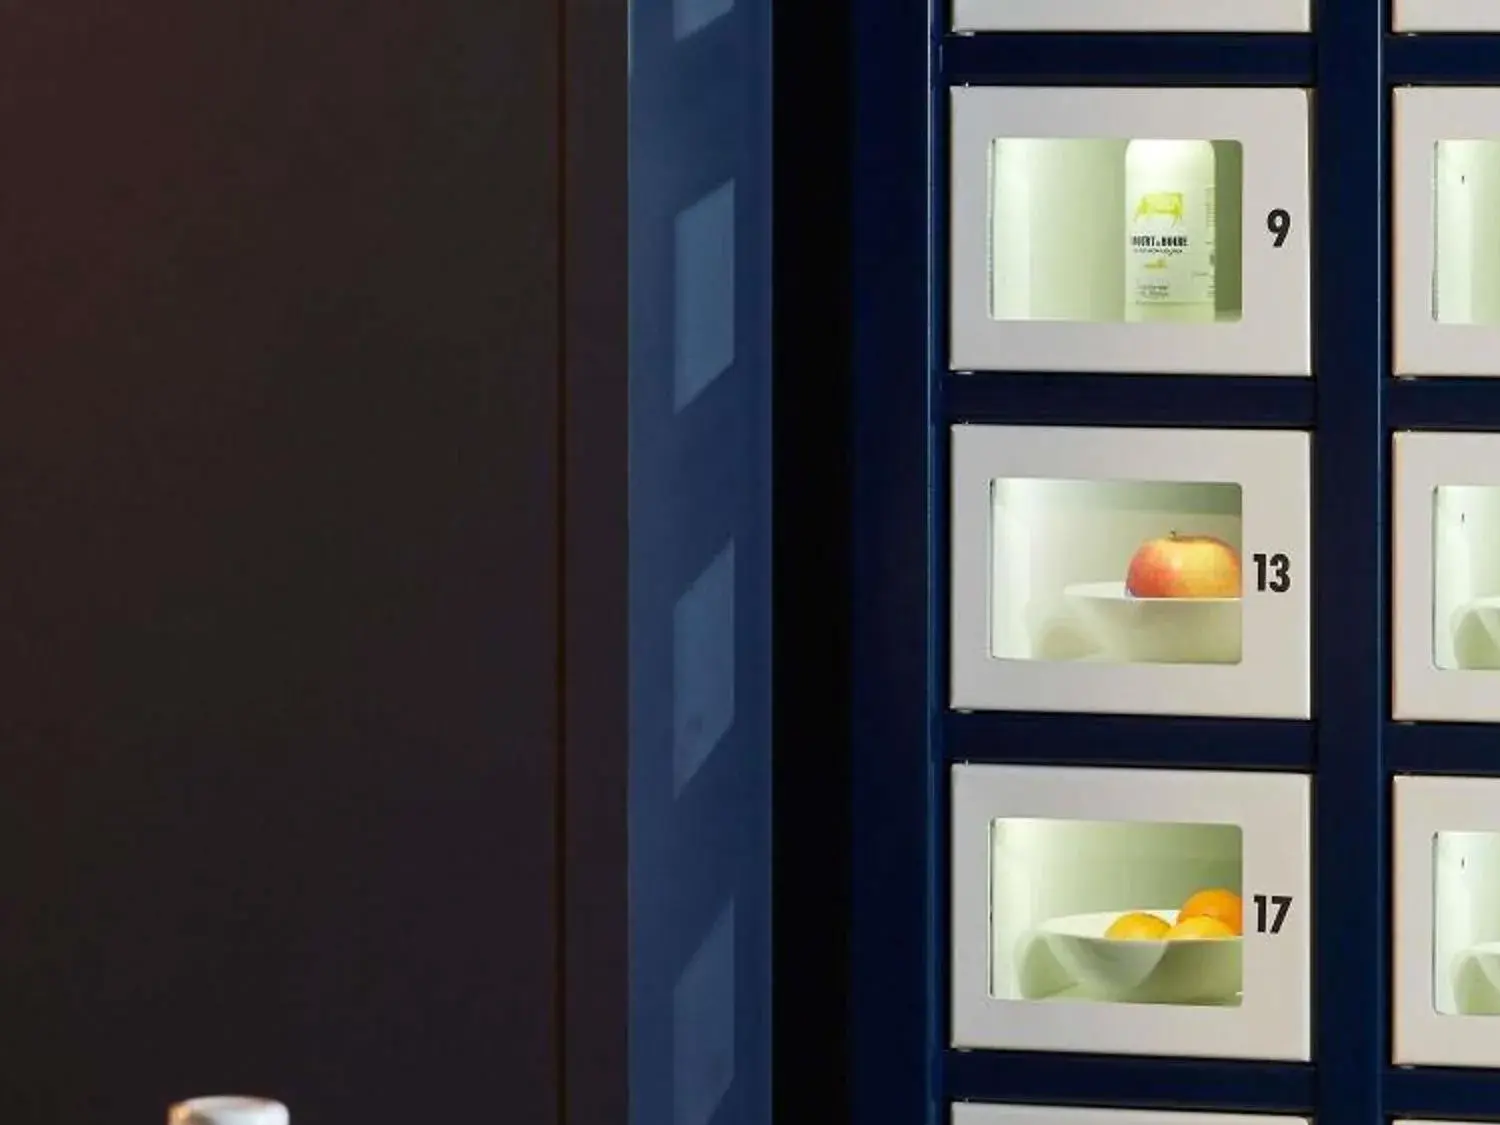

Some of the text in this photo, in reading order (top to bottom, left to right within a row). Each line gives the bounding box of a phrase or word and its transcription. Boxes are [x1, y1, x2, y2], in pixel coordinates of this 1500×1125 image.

[1266, 208, 1291, 248] 9
[1253, 553, 1291, 593] 13
[1253, 894, 1293, 934] 17
